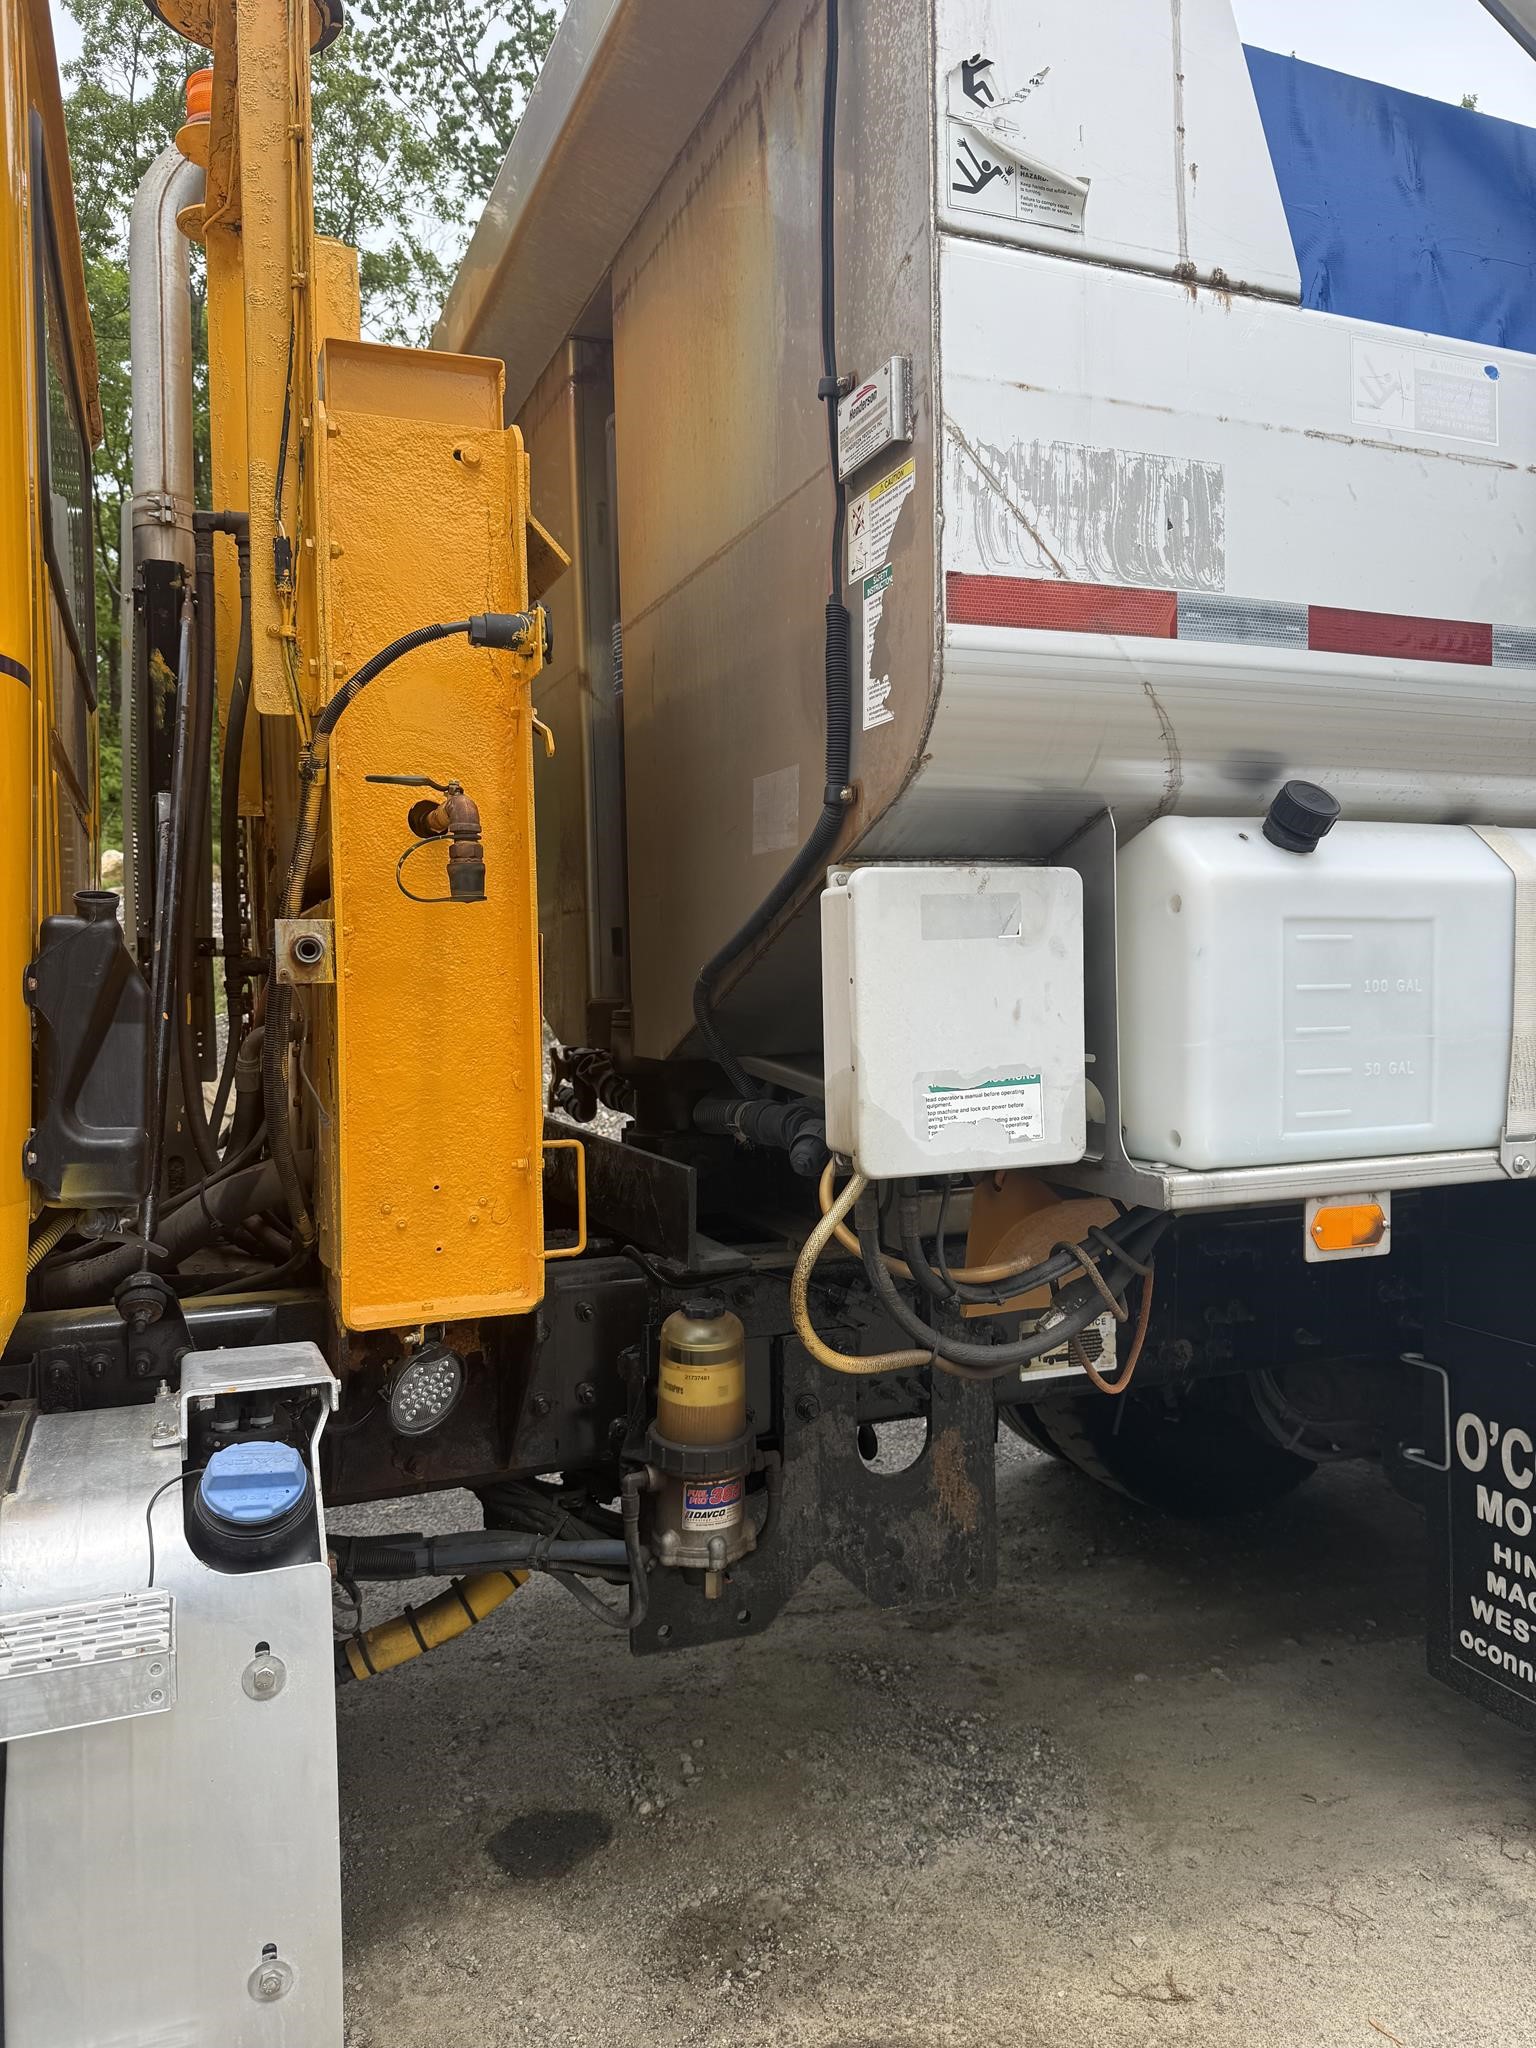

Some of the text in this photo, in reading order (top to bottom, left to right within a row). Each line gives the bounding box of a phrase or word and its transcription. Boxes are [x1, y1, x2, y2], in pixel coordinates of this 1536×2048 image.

[1020, 195, 1035, 203] Failure
[849, 390, 878, 422] Henderson
[884, 469, 904, 489] CAUTION
[873, 570, 889, 585] SAFETY
[1364, 978, 1423, 993] 100 GAL
[1364, 1060, 1415, 1076] 50 GAL
[1456, 1412, 1536, 1490] O'C
[692, 1509, 726, 1519] DAVCO
[1476, 1484, 1536, 1537] MO
[1460, 1629, 1536, 1683] oconn
